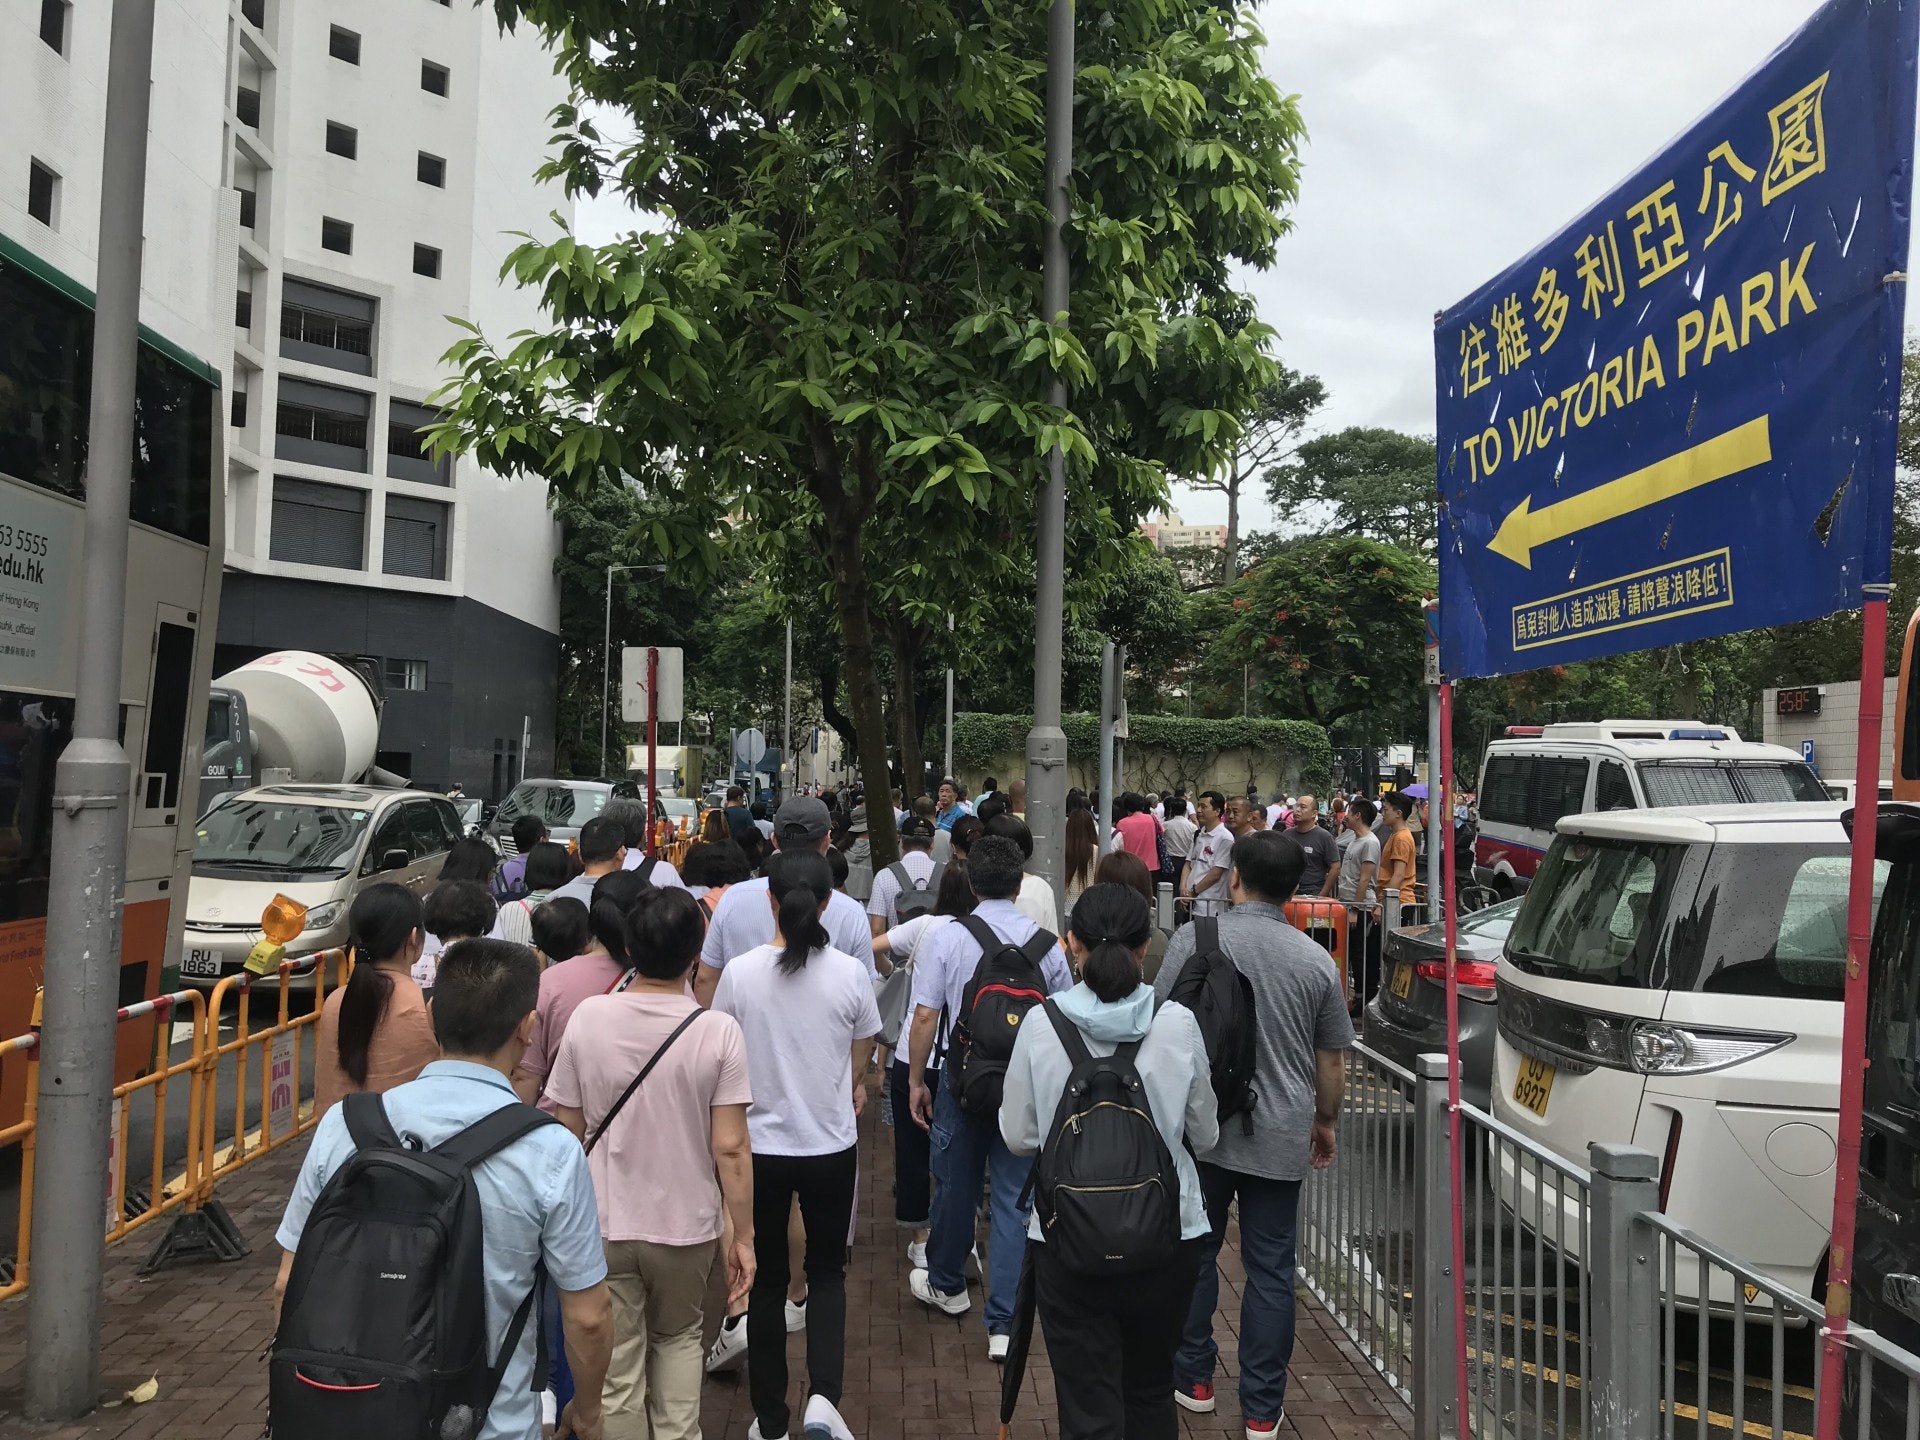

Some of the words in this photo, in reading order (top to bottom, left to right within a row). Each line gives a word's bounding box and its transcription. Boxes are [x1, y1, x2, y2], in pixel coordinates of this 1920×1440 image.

[1459, 70, 1830, 399] 往維多利亞公園
[1463, 426, 1503, 484] TO
[1507, 333, 1666, 463] VICTORIA
[1677, 241, 1818, 378] PARK
[16, 529, 48, 557] 5555
[5, 593, 22, 609] Hong
[23, 597, 40, 612] Kong
[1803, 742, 1812, 761] P
[207, 765, 226, 776] GOLIK
[191, 950, 211, 961] RU
[183, 960, 217, 974] 1863
[1515, 1076, 1547, 1111] 6927
